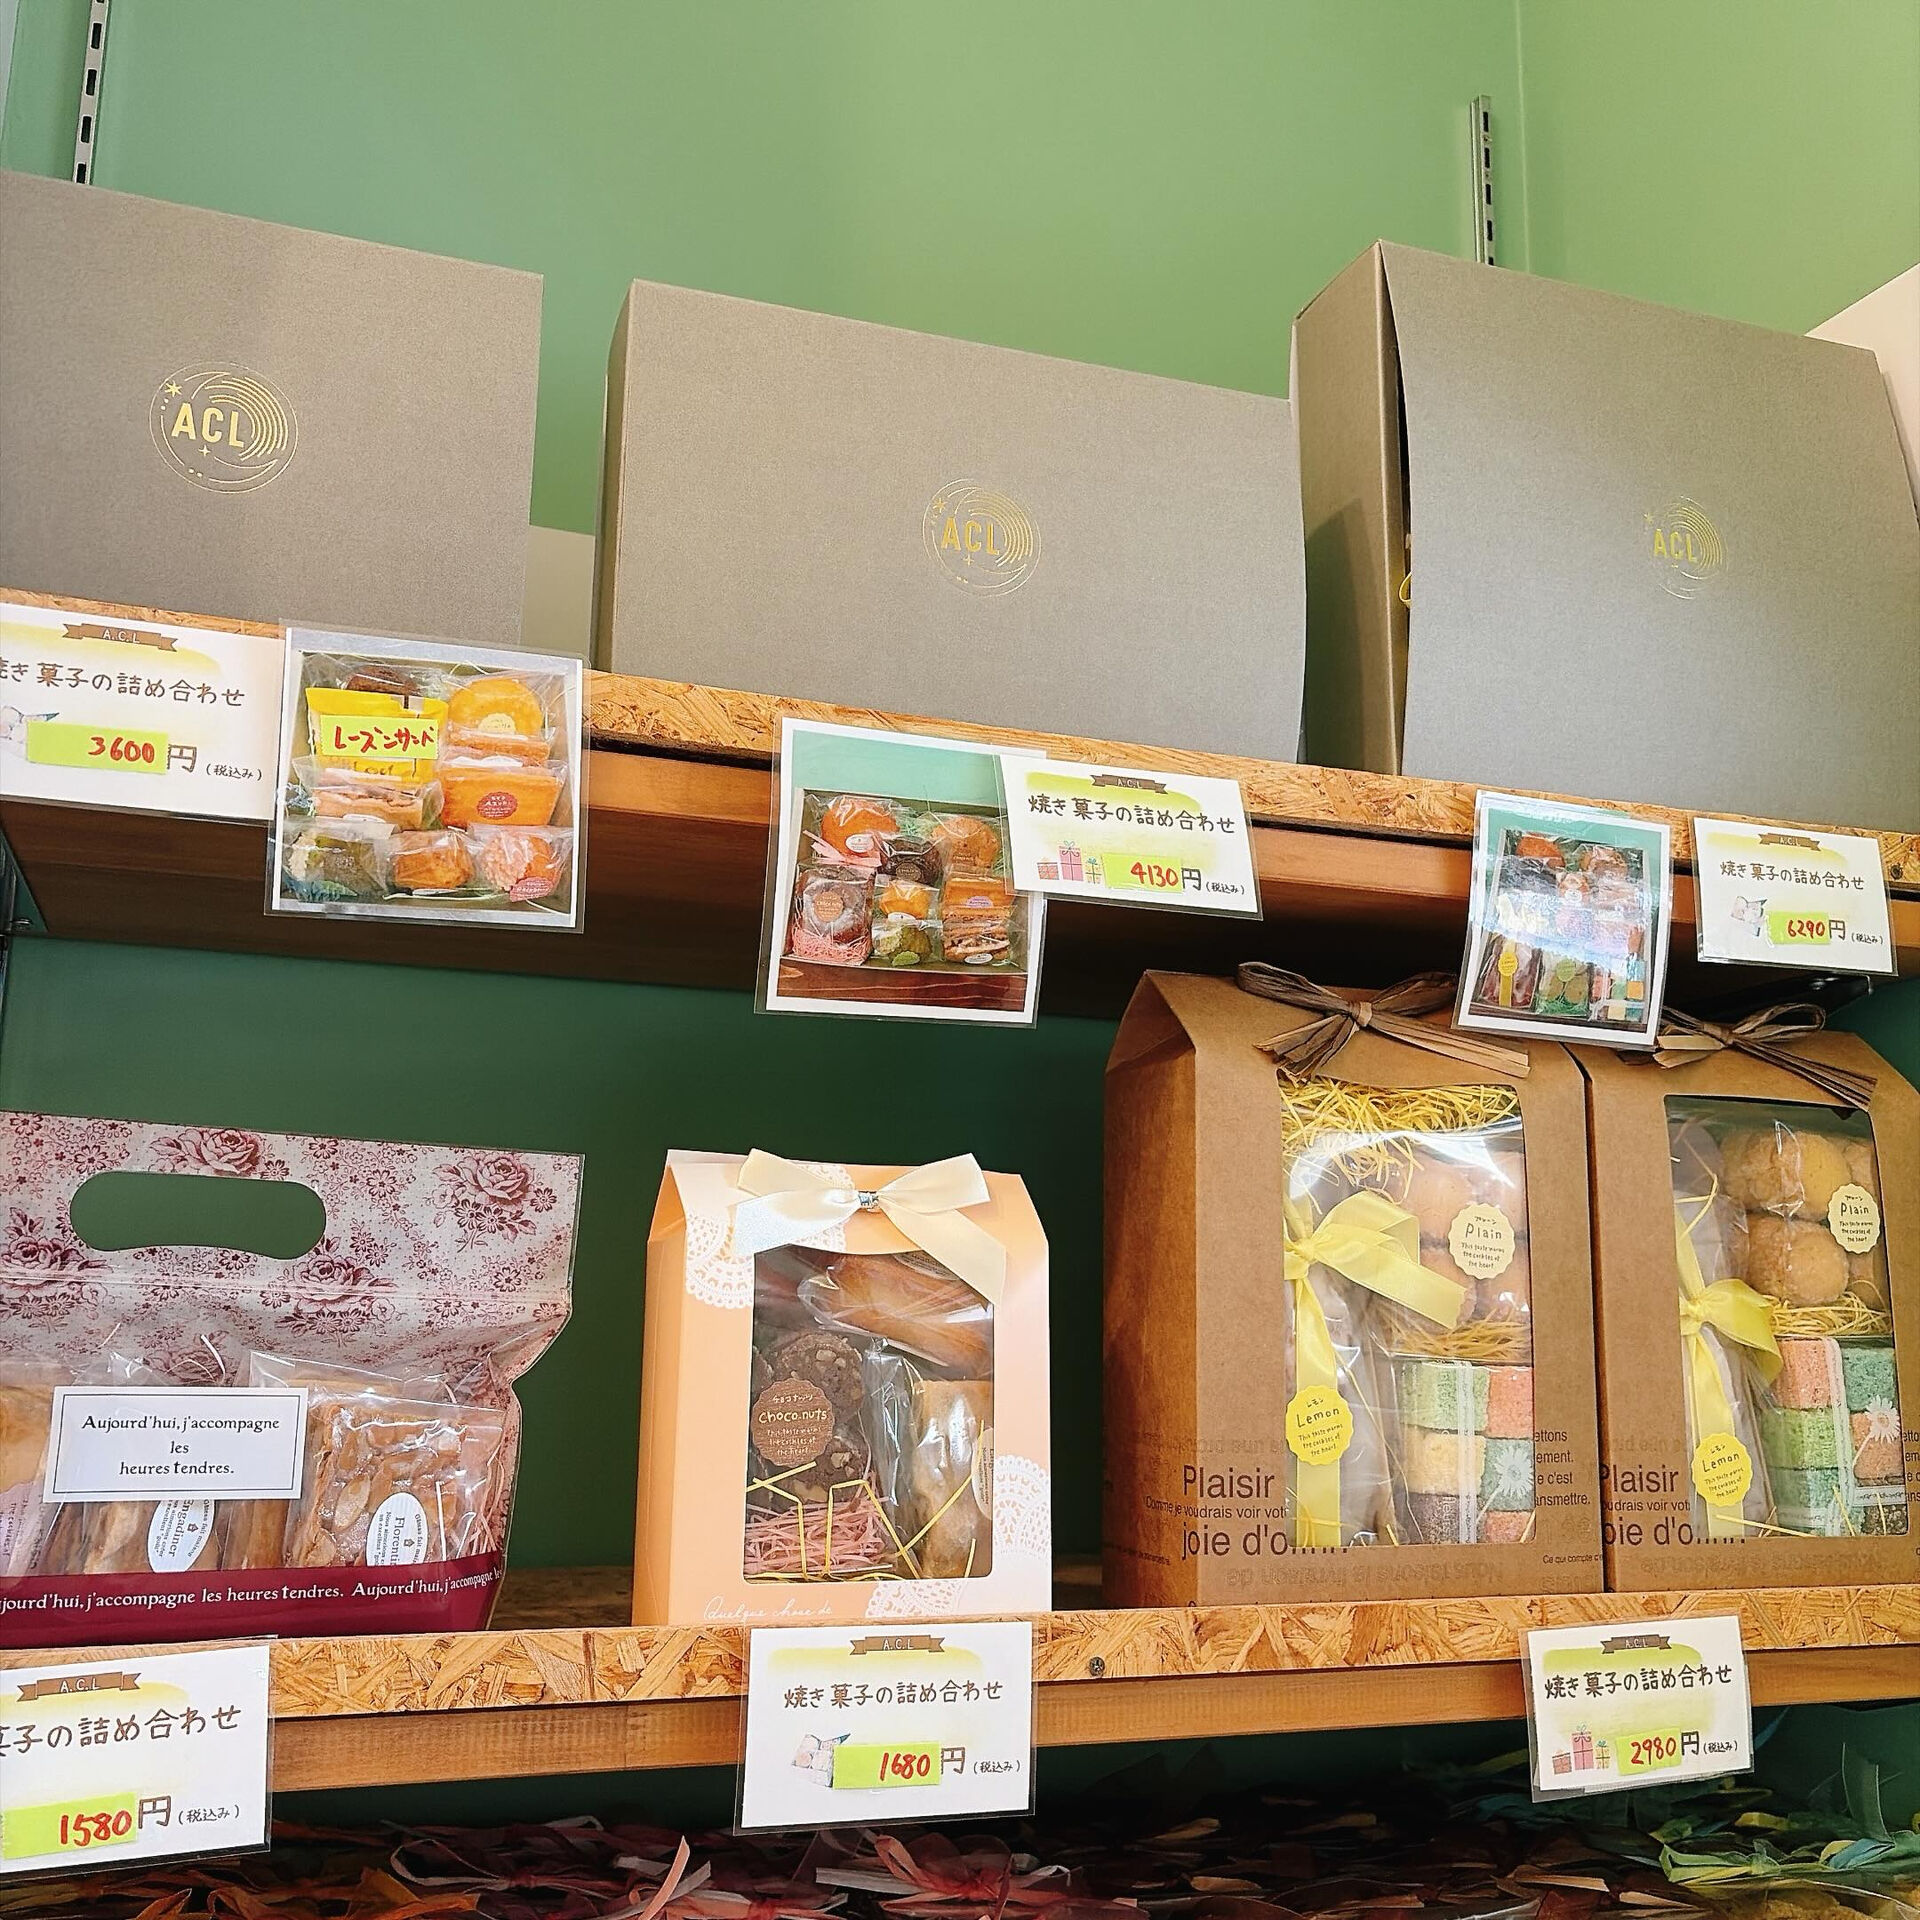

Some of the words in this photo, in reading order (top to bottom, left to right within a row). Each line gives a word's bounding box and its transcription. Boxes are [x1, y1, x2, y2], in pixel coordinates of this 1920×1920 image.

[171, 402, 245, 448] ACL
[941, 516, 1000, 555] ACL
[1654, 528, 1697, 563] ACL
[1028, 793, 1236, 834] 焼き菓子の詰め合わせ
[1720, 860, 1864, 890] 焼き菓子の詰め合わせ
[1841, 1202, 1869, 1216] Plain
[1465, 1223, 1502, 1239] Plain
[81, 1415, 181, 1434] Aujourd'hui,
[181, 1416, 280, 1434] j'accompagne
[1296, 1408, 1340, 1428] Lemon
[170, 1441, 189, 1454] les
[1536, 1450, 1574, 1463] ement.
[120, 1462, 170, 1475] heures
[173, 1460, 234, 1475] tendres.
[1702, 1453, 1740, 1472] Lemon
[1183, 1465, 1275, 1499] Plaisir
[1547, 1472, 1573, 1485] c'est
[1183, 1503, 1232, 1519] voudrais
[1236, 1505, 1260, 1519] voir
[1265, 1505, 1287, 1519] vot
[1646, 1500, 1668, 1512] voir
[1672, 1500, 1691, 1512] vot
[1181, 1522, 1230, 1561] joie
[1602, 1516, 1643, 1546] oie
[0, 1592, 84, 1614] jourd'hui,
[84, 1591, 196, 1613] j'accompagne
[202, 1588, 222, 1603] les
[227, 1585, 279, 1601] heures
[282, 1584, 344, 1600] tendres.
[352, 1579, 443, 1600] Aujourd'hui,
[1545, 1663, 1733, 1699] 焼き菓子の詰め合わせ
[784, 1679, 1003, 1709] 焼き菓子の詰め合わせ
